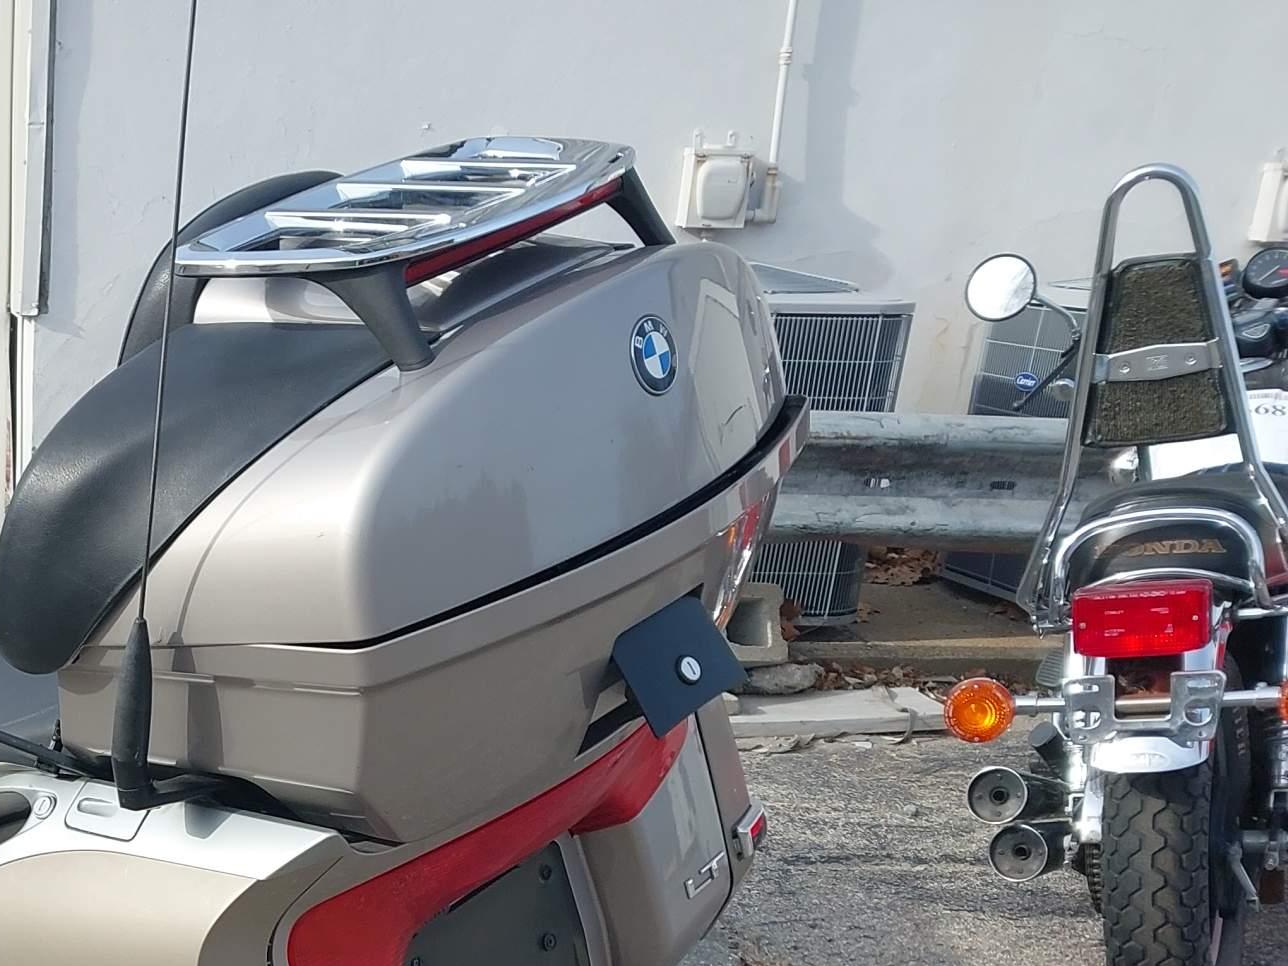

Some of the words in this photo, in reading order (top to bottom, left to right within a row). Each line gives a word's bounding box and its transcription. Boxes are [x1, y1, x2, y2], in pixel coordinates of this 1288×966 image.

[634, 320, 669, 349] BMW
[1093, 538, 1228, 560] ONDA
[683, 850, 726, 900] LT
